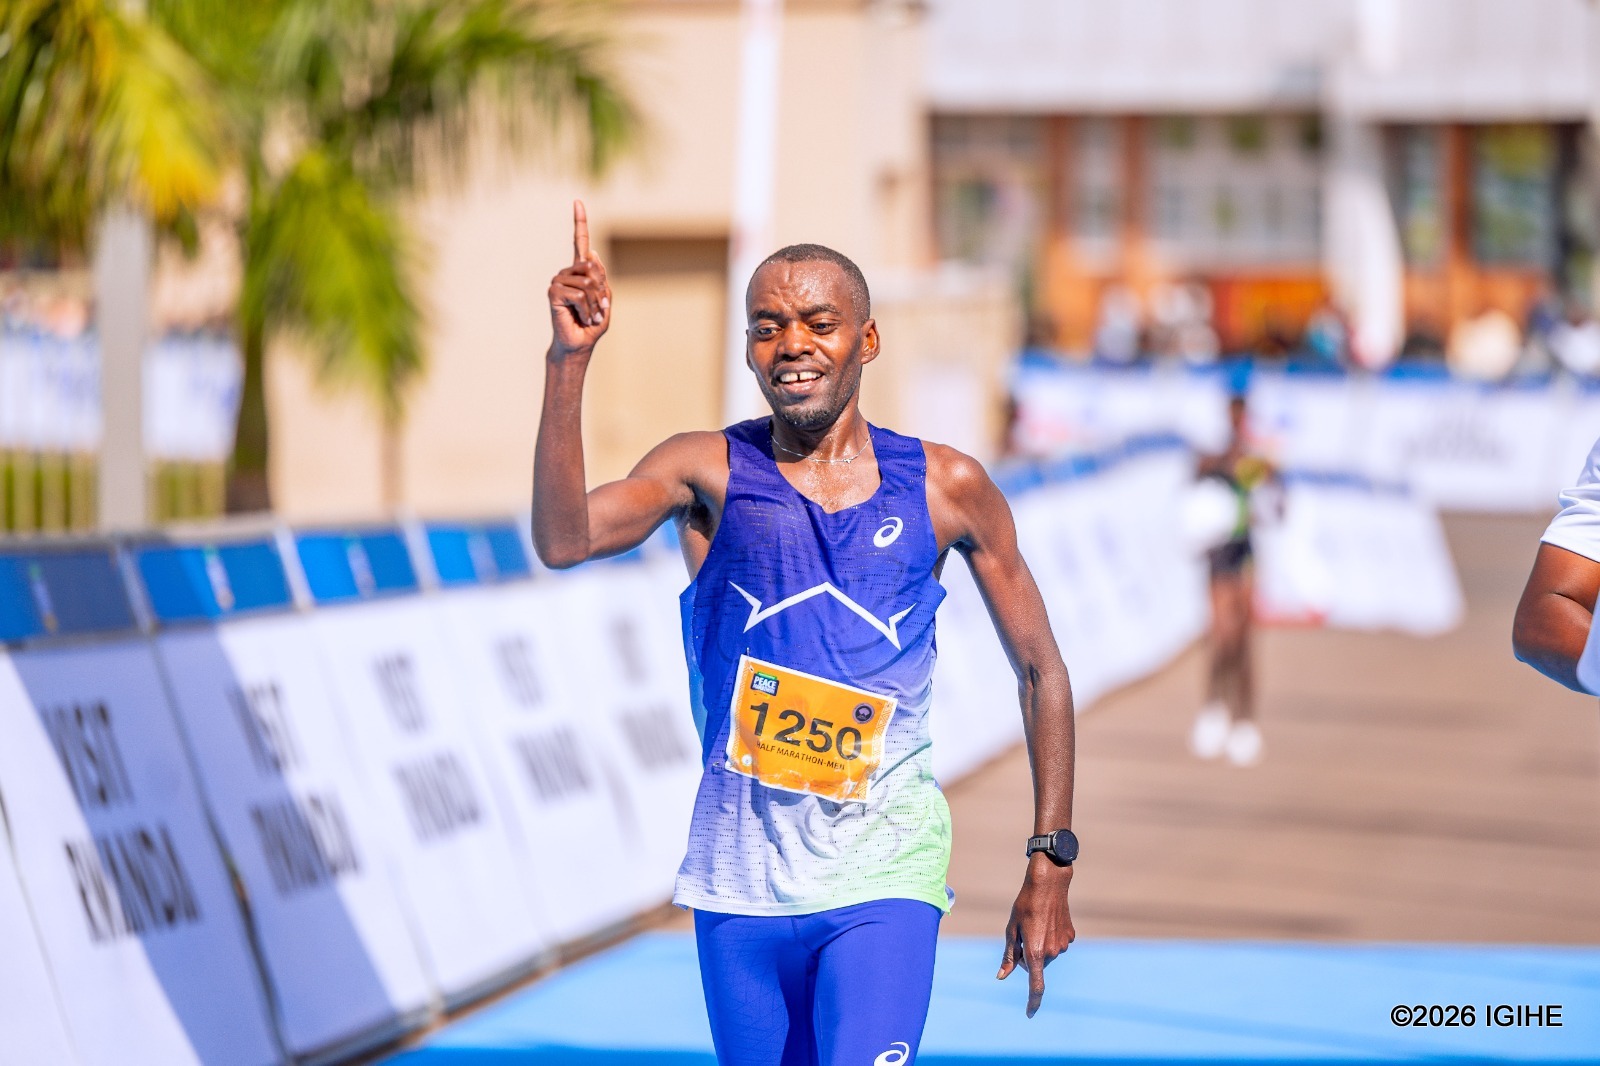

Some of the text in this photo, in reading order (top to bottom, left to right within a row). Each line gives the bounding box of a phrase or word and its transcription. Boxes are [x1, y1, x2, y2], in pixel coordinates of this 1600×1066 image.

[753, 675, 777, 688] PEACE
[750, 702, 862, 761] 1250
[756, 741, 776, 753] HALF
